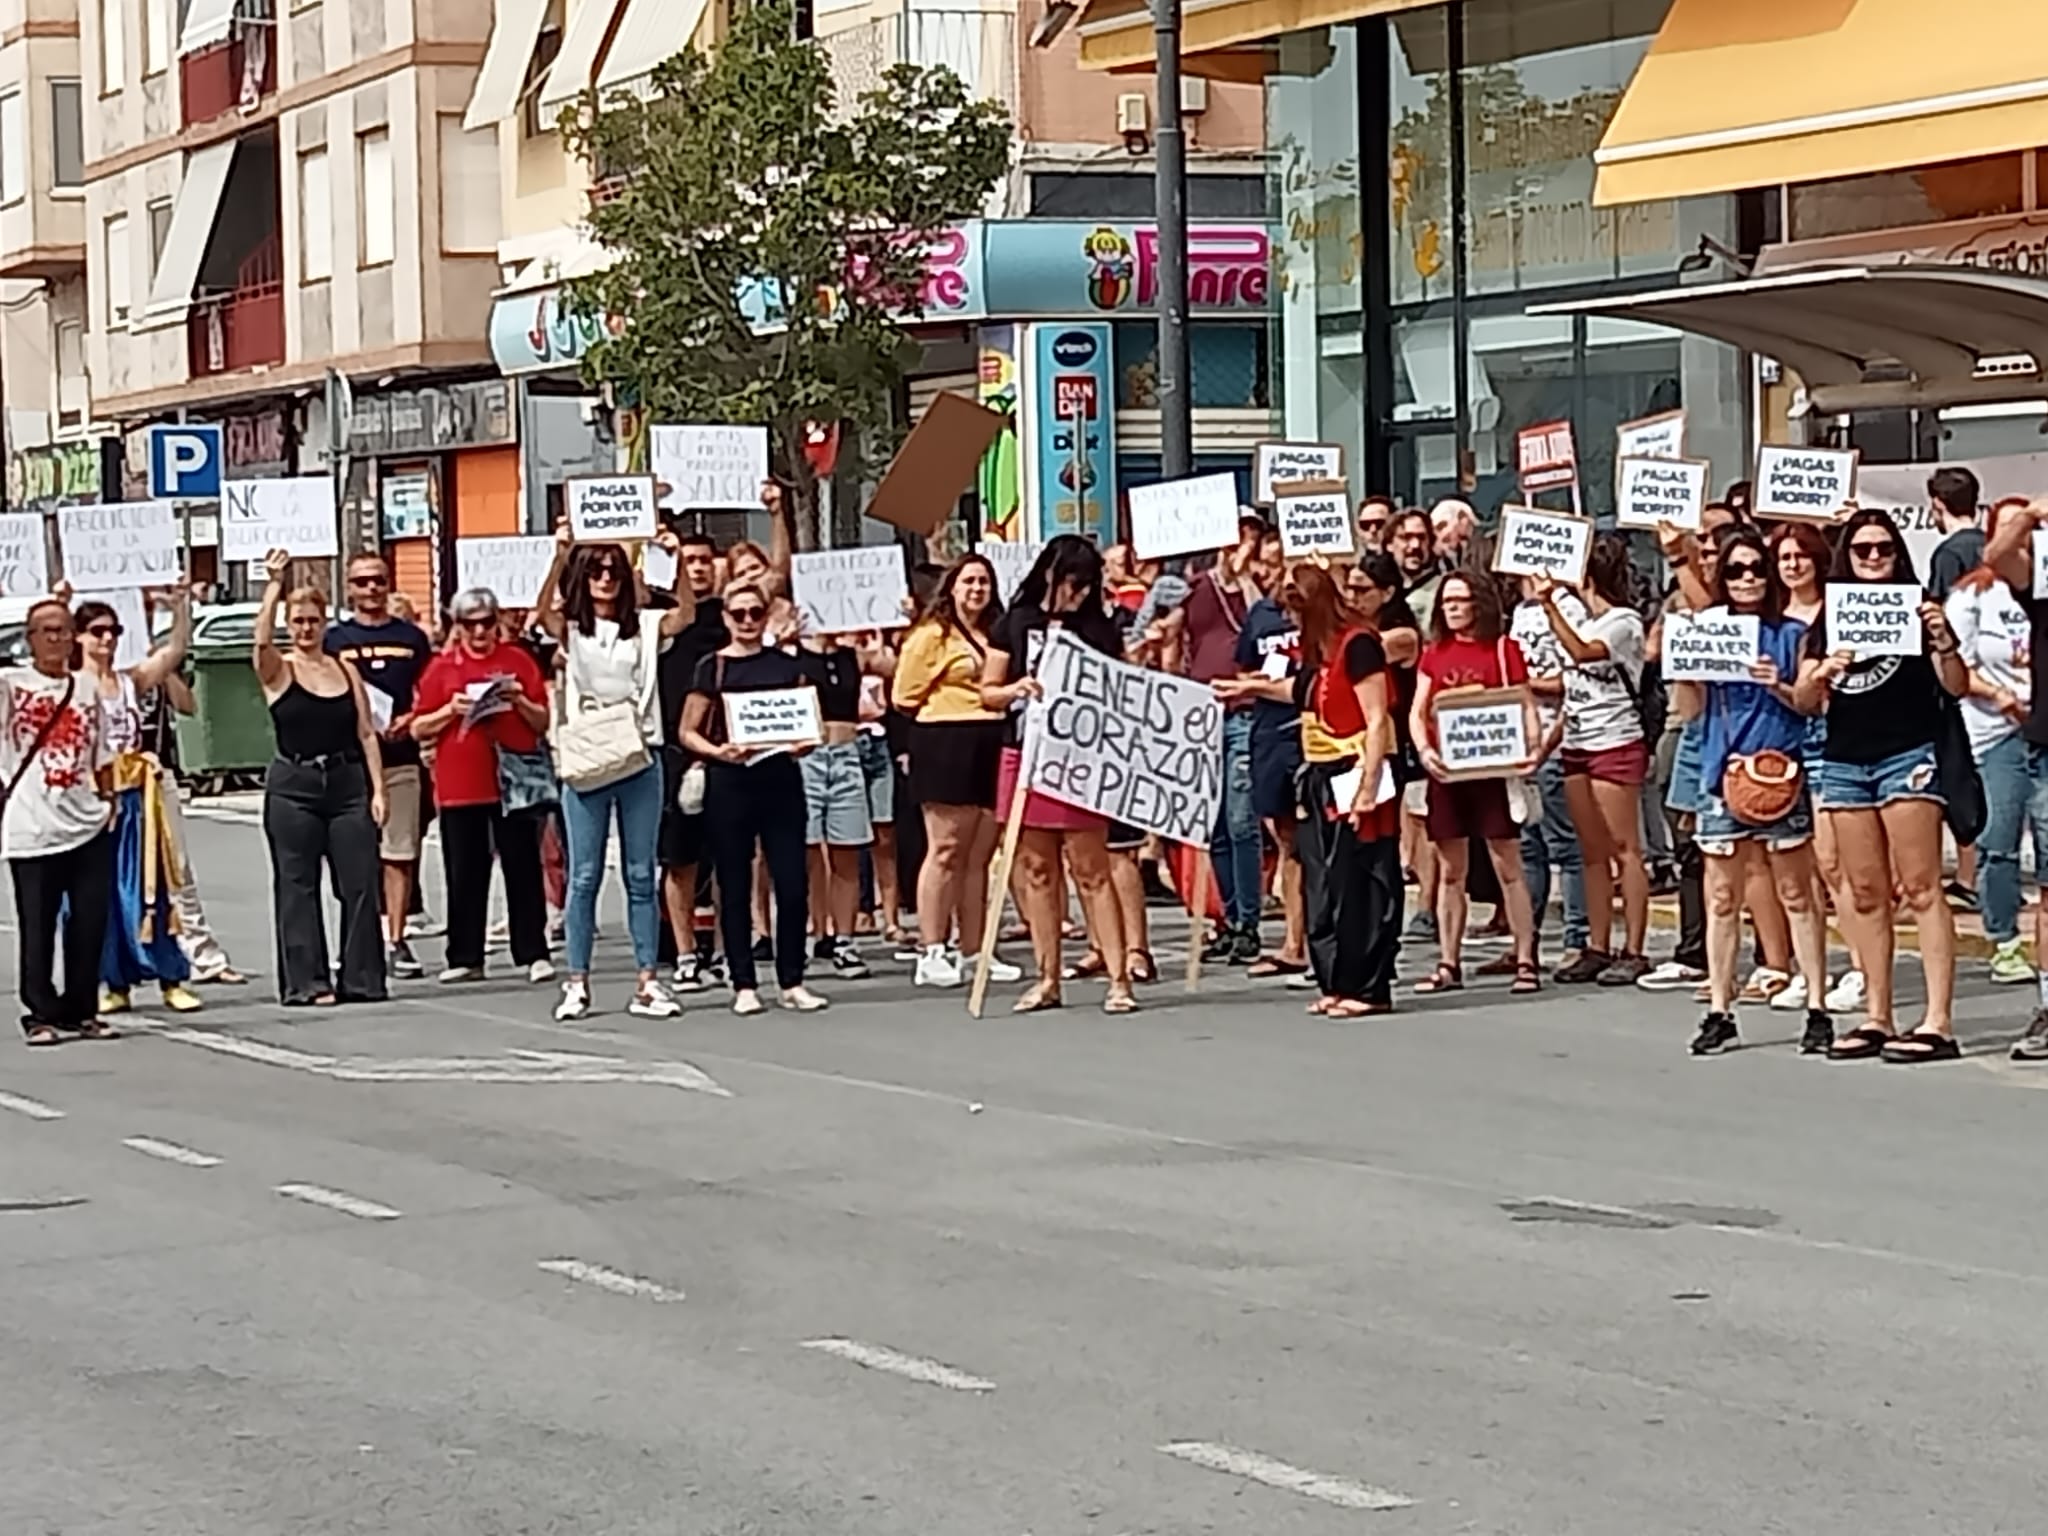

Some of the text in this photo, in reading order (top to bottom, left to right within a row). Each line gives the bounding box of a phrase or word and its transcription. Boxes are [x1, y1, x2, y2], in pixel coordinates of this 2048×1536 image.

[163, 435, 208, 492] P
[1271, 451, 1326, 466] ¿PAGAS
[1773, 456, 1835, 473] ¿PAGAS
[1770, 473, 1839, 490] POR VER
[581, 484, 638, 502] ¿PAGAS
[1662, 487, 1691, 501] VER
[1771, 490, 1831, 506] MORIR?
[580, 500, 643, 514] POR VER
[1288, 501, 1337, 517] ¿PAGAS
[583, 516, 639, 529] MORIR?
[1320, 517, 1344, 529] VER
[1516, 522, 1573, 540] ¿PAGAS
[1514, 536, 1575, 556] POR VER
[1838, 592, 1904, 608] ¿PAGAS
[1836, 611, 1910, 626] POR VER
[1838, 629, 1902, 644] MORIR?
[1670, 639, 1752, 657] PARA VER
[1183, 702, 1219, 752] el
[1451, 712, 1508, 731] ¿PAGAS
[1446, 727, 1517, 745] PARA VER
[1041, 748, 1213, 845] de PIEDRA
